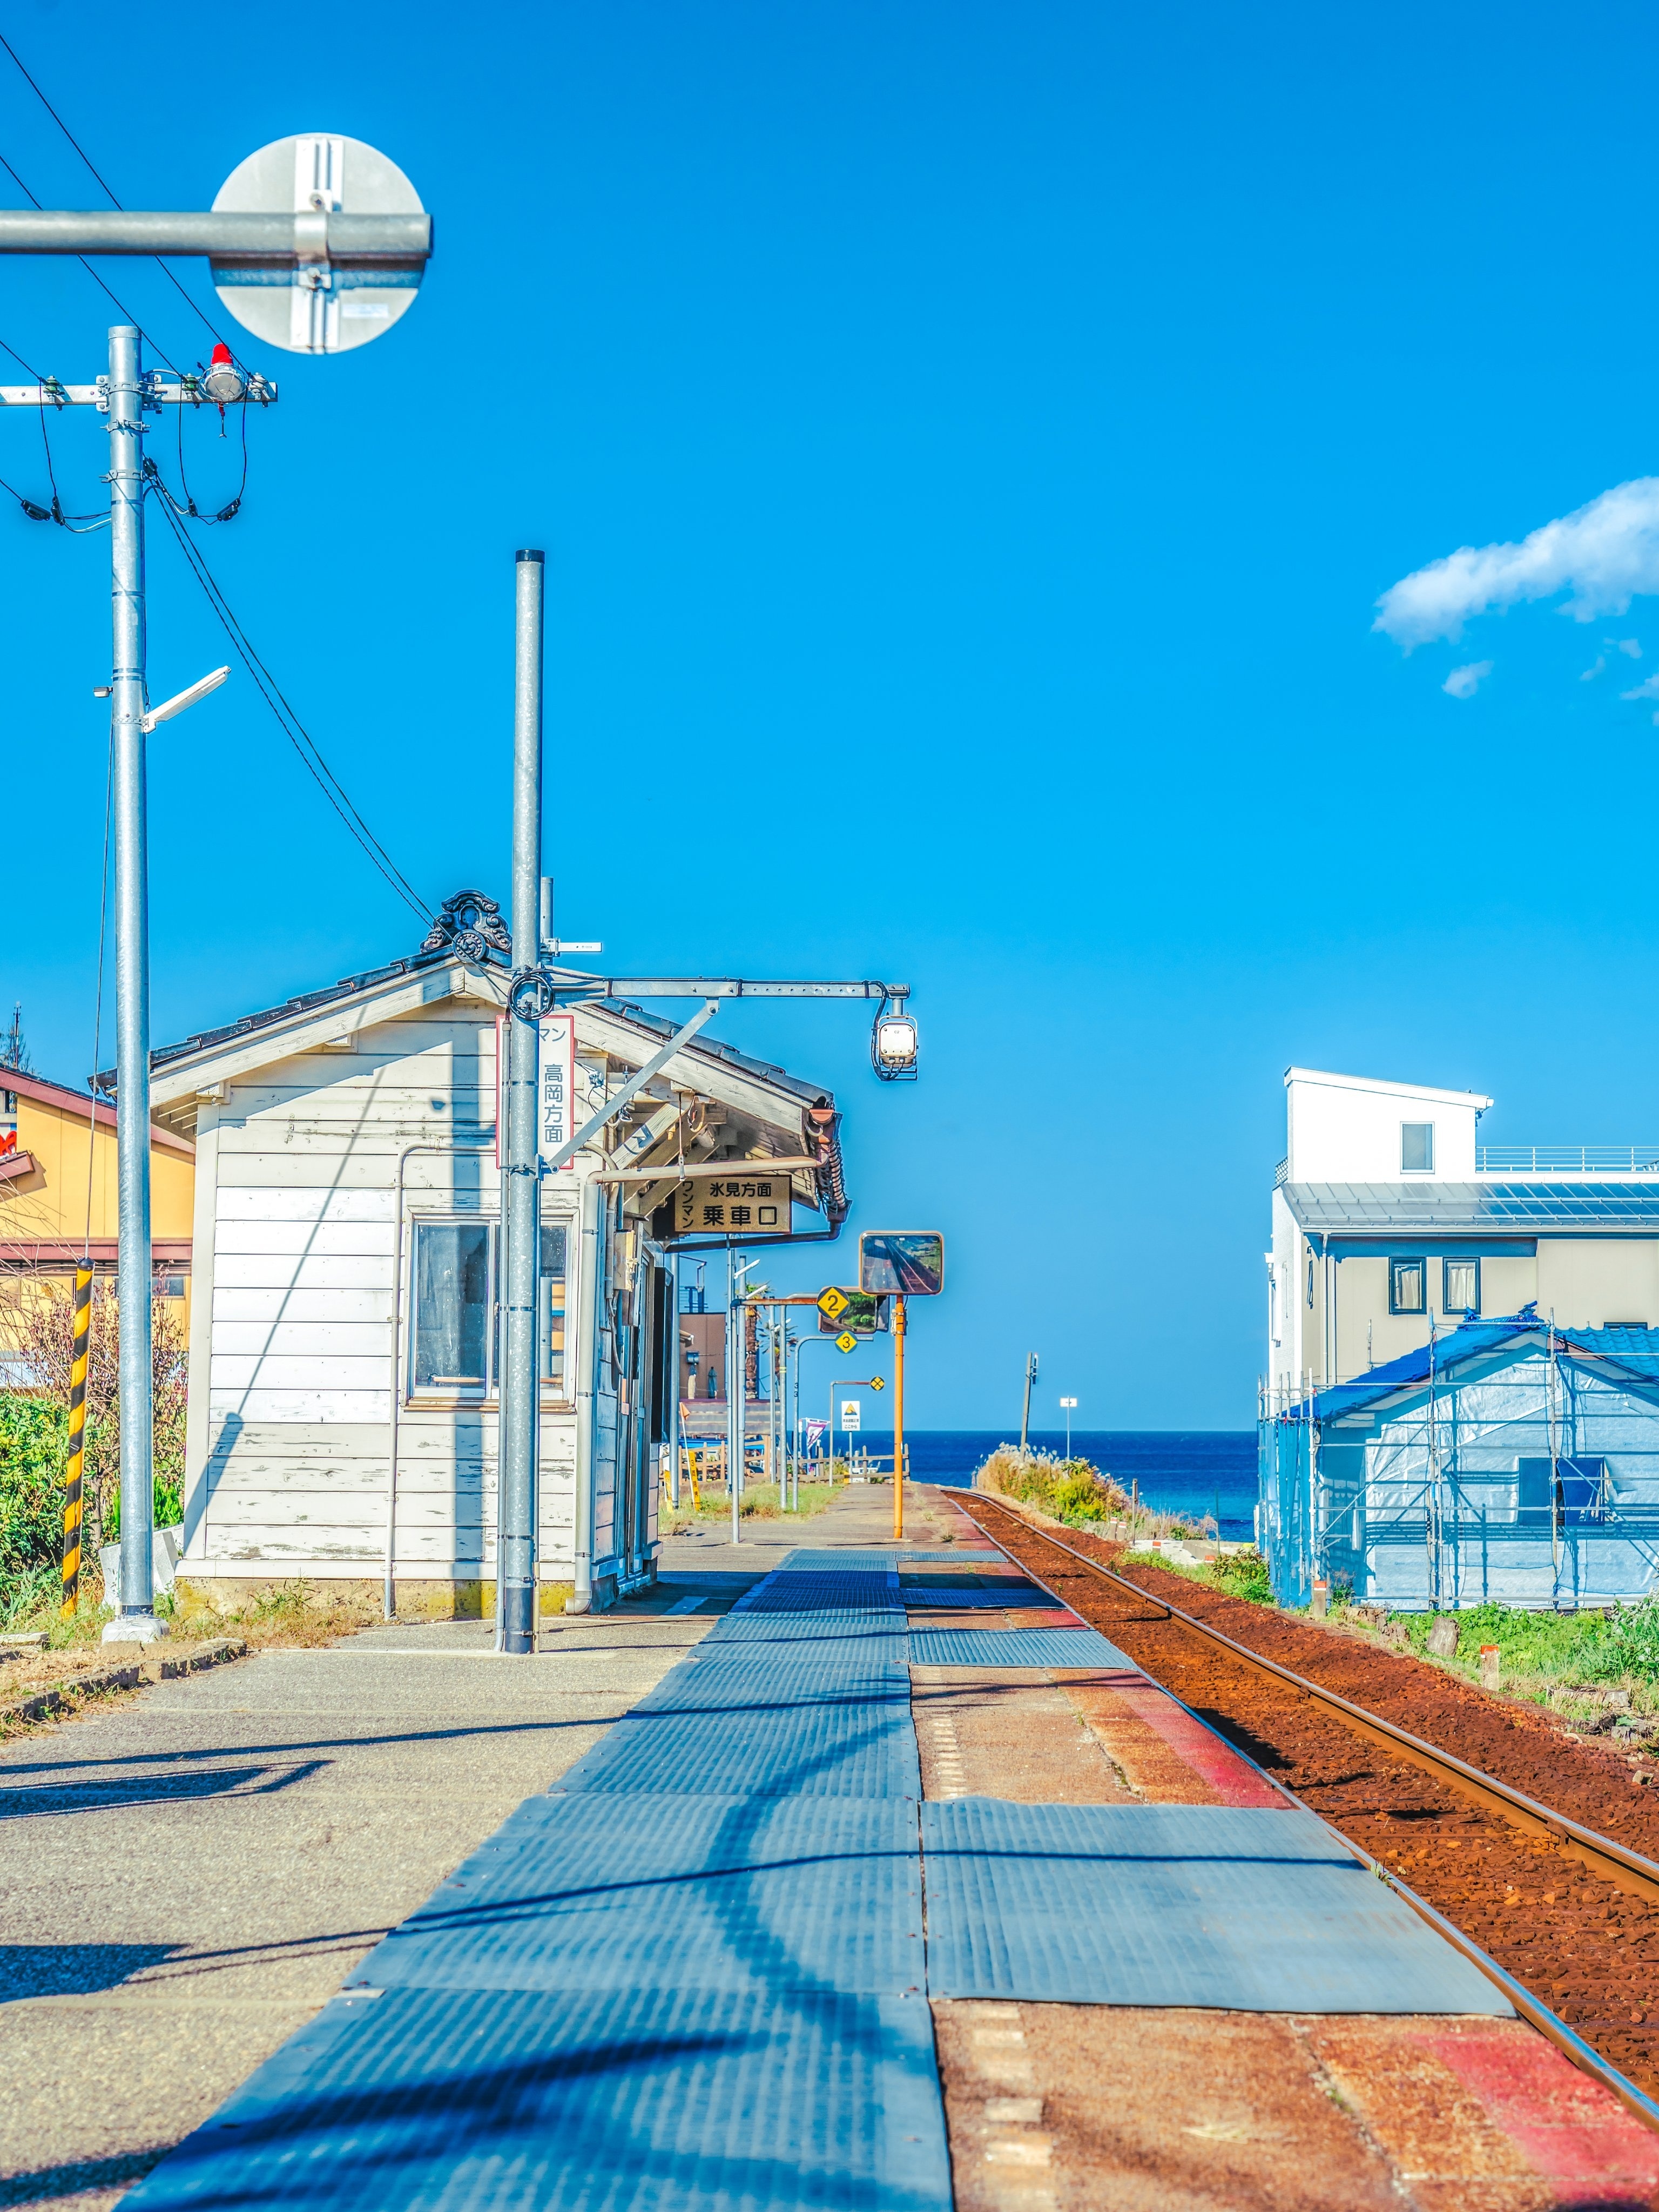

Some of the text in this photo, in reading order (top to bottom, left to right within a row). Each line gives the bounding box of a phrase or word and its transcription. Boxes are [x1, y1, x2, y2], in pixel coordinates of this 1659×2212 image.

[544, 1064, 563, 1143] 高岡方面
[710, 1182, 772, 1198] 氷見方面
[682, 1181, 694, 1229] ワンマン
[703, 1205, 777, 1226] 乗車口
[827, 1294, 839, 1312] 2
[842, 1336, 851, 1348] 3
